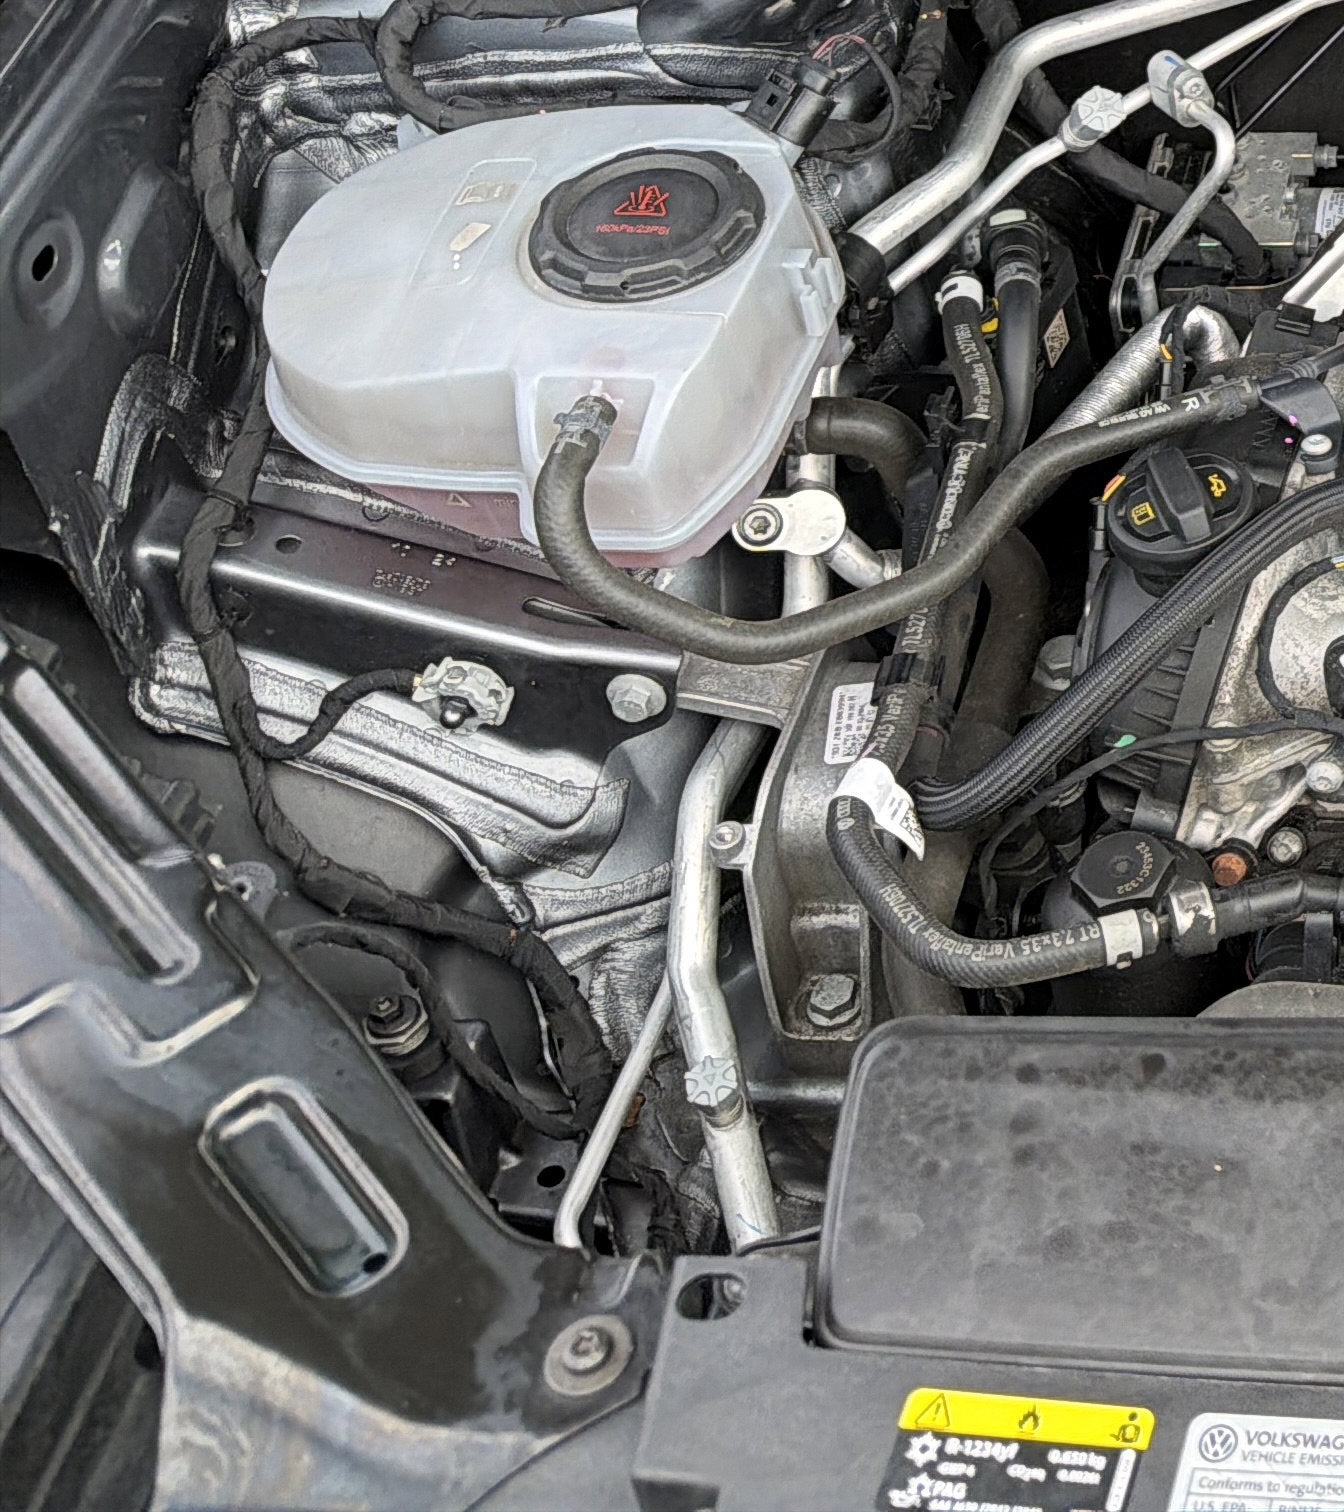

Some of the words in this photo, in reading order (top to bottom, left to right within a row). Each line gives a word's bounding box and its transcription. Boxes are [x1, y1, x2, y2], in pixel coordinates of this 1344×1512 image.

[1079, 921, 1102, 942] RT
[1242, 1449, 1297, 1465] VEHICLE
[932, 1480, 967, 1500] PAG
[1199, 1475, 1264, 1492] Conforms
[1266, 1479, 1281, 1494] to
